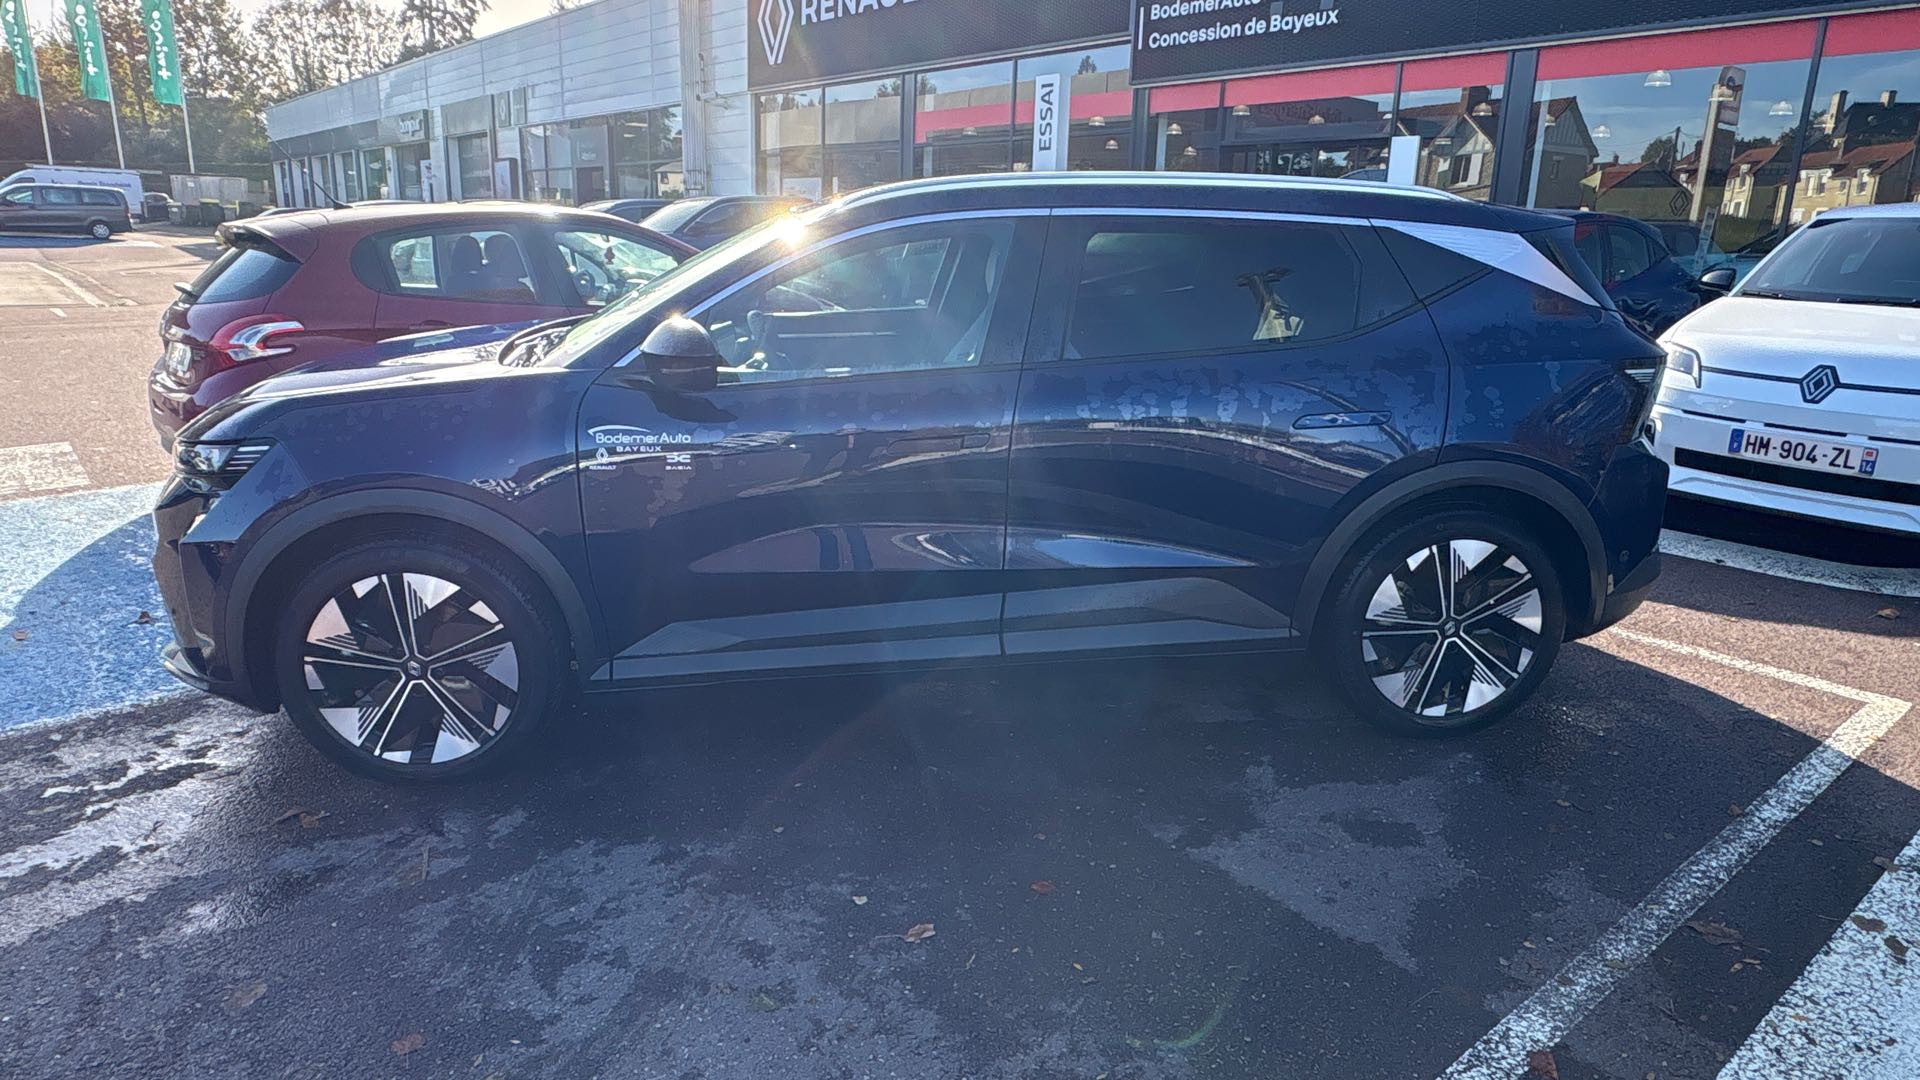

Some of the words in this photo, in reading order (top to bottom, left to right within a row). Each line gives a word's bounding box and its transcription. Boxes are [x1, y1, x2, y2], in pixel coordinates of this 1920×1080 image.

[801, 0, 919, 26] RENA
[1149, 21, 1241, 49] Concession
[1244, 16, 1267, 36] de
[1269, 9, 1340, 34] Bayeux
[1039, 82, 1055, 152] ESSAI
[595, 432, 691, 444] BodemerAuto
[616, 445, 662, 453] BAYEUX
[1743, 434, 1856, 471] HM-904-ZL
[1861, 461, 1873, 473] 14
